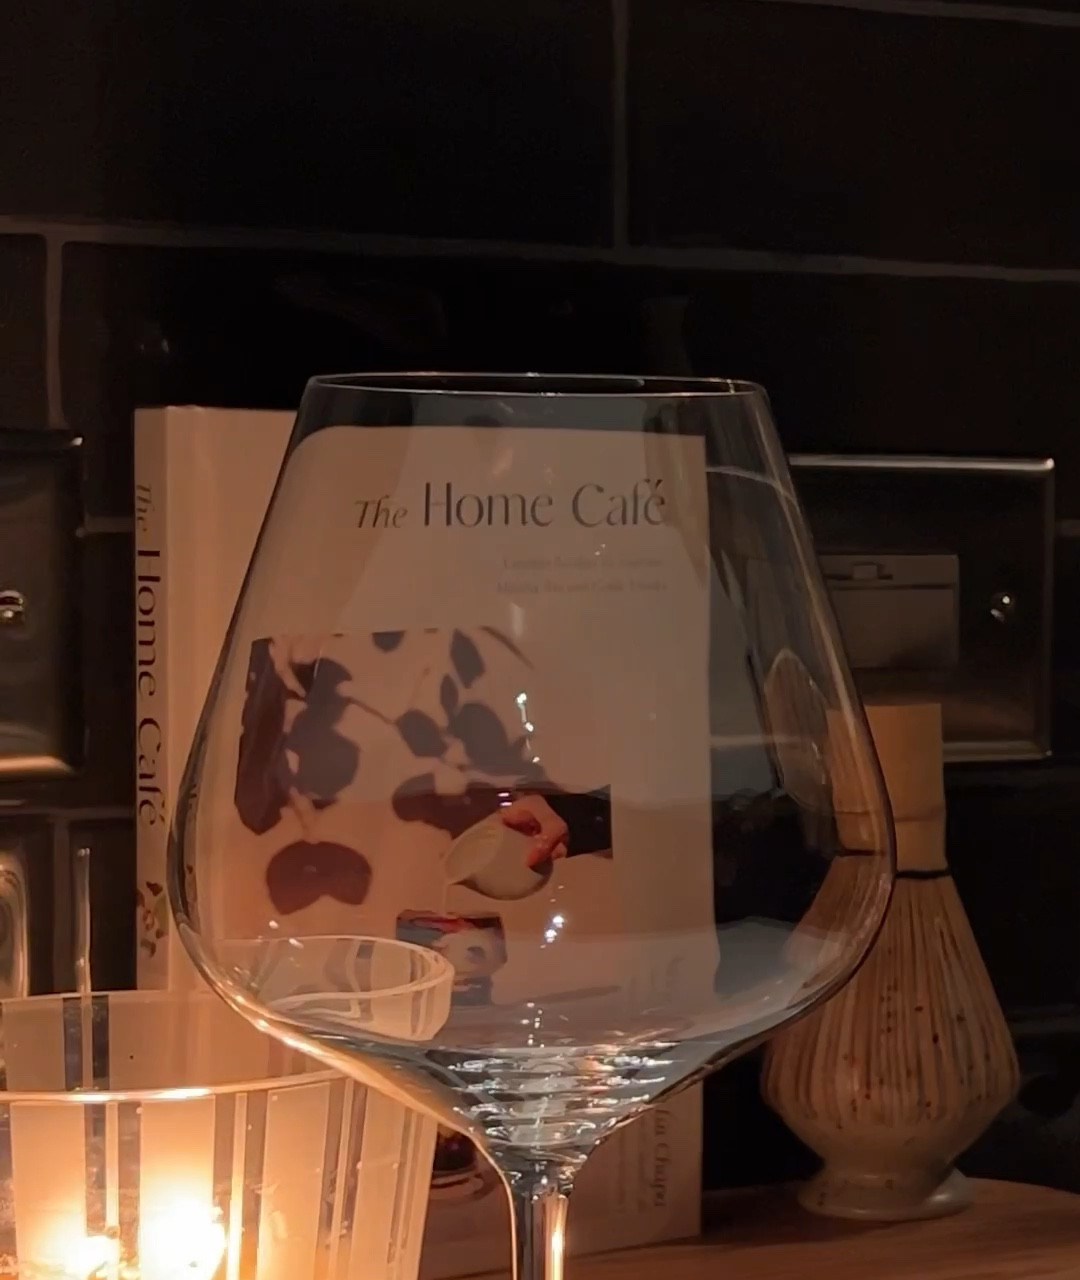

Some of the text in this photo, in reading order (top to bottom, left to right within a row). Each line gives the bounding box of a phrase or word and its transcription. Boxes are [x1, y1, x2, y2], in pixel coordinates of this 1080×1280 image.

[354, 478, 666, 529] The Home Café
[136, 484, 167, 826] The Home Café
